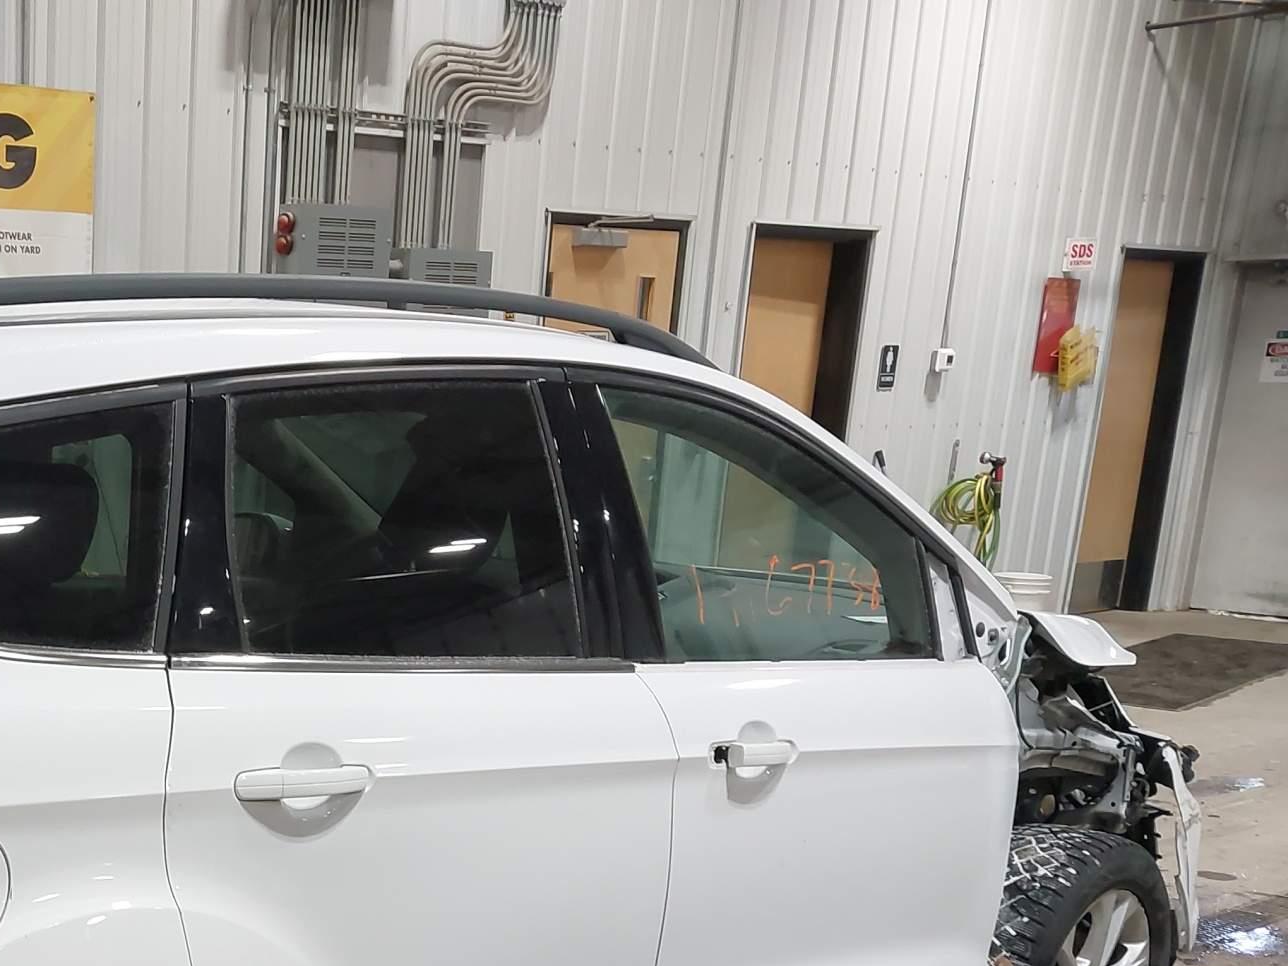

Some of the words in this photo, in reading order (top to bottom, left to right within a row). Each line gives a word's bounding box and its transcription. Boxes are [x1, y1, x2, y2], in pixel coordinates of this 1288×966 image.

[4, 244, 18, 254] ON
[19, 245, 41, 255] YARD
[1071, 243, 1094, 259] SDS
